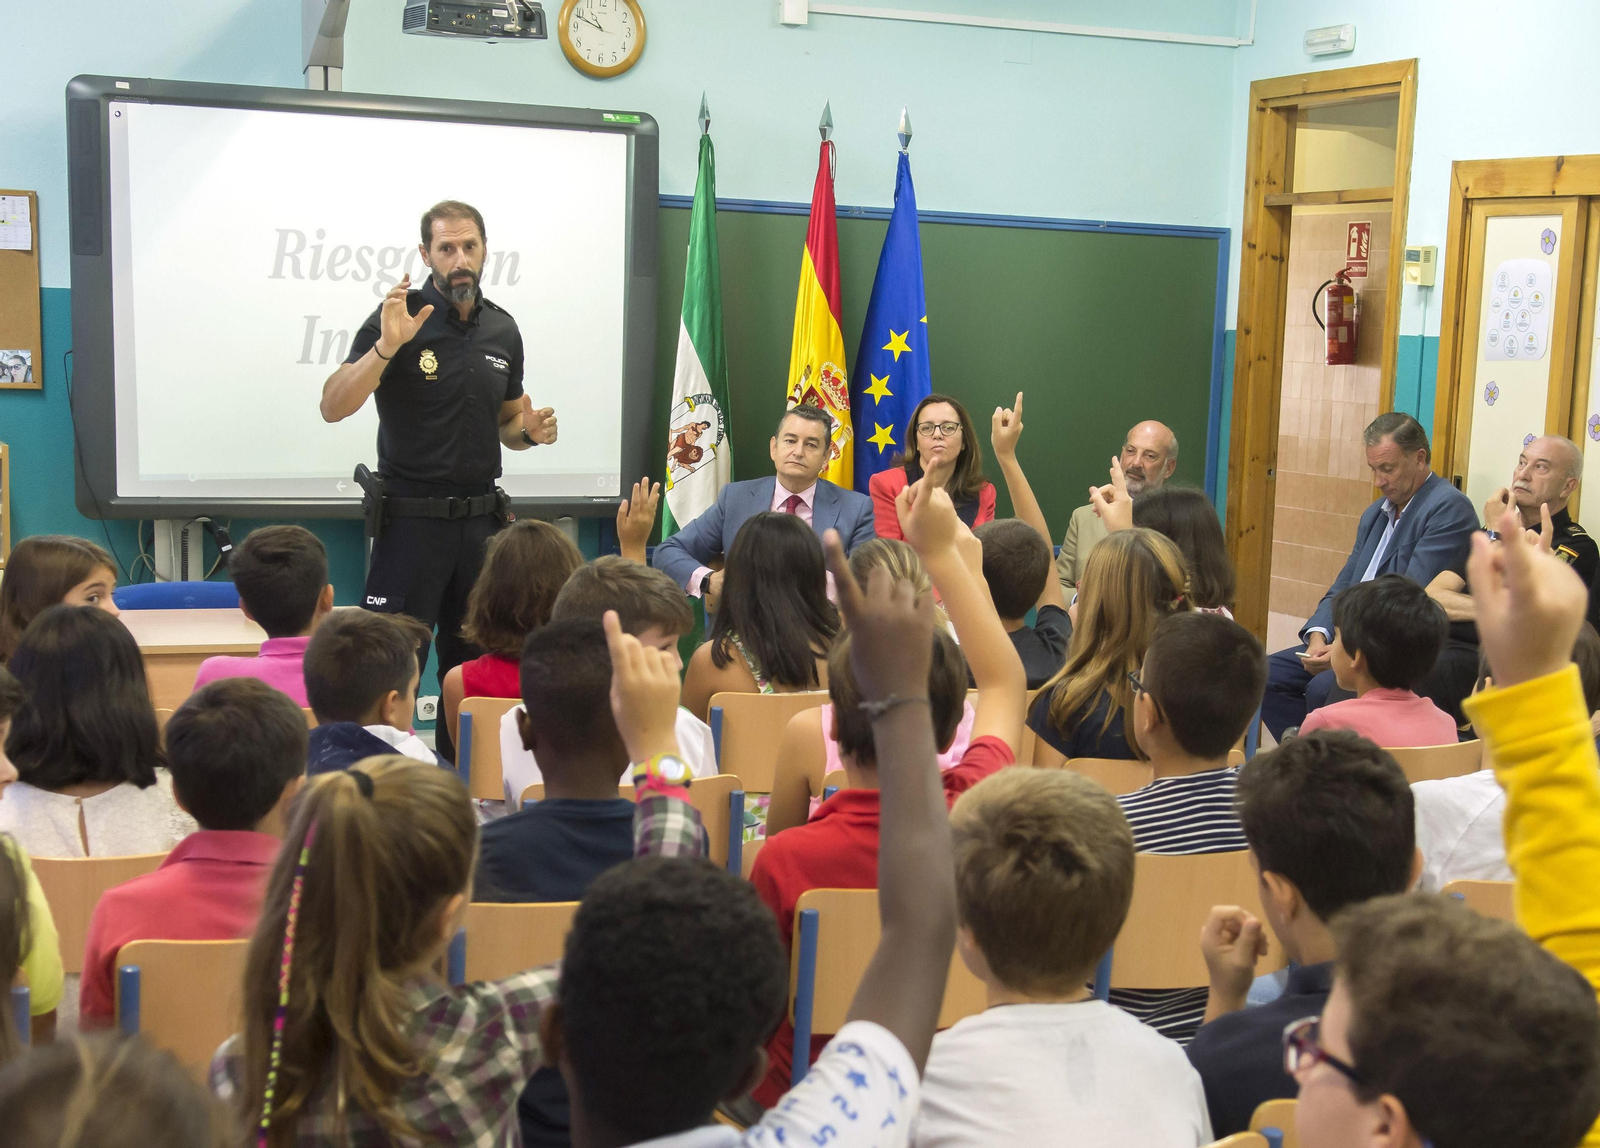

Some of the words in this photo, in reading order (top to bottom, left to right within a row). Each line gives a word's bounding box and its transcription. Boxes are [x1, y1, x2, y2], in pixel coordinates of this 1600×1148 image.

[576, 7, 584, 18] 10
[621, 12, 628, 23] 2
[573, 21, 579, 33] 9
[625, 27, 631, 38] 3
[575, 36, 582, 48] 8
[621, 41, 626, 52] 4
[586, 48, 591, 60] 7
[598, 53, 604, 64] 6
[611, 51, 617, 62] 5
[366, 595, 387, 606] CNP
